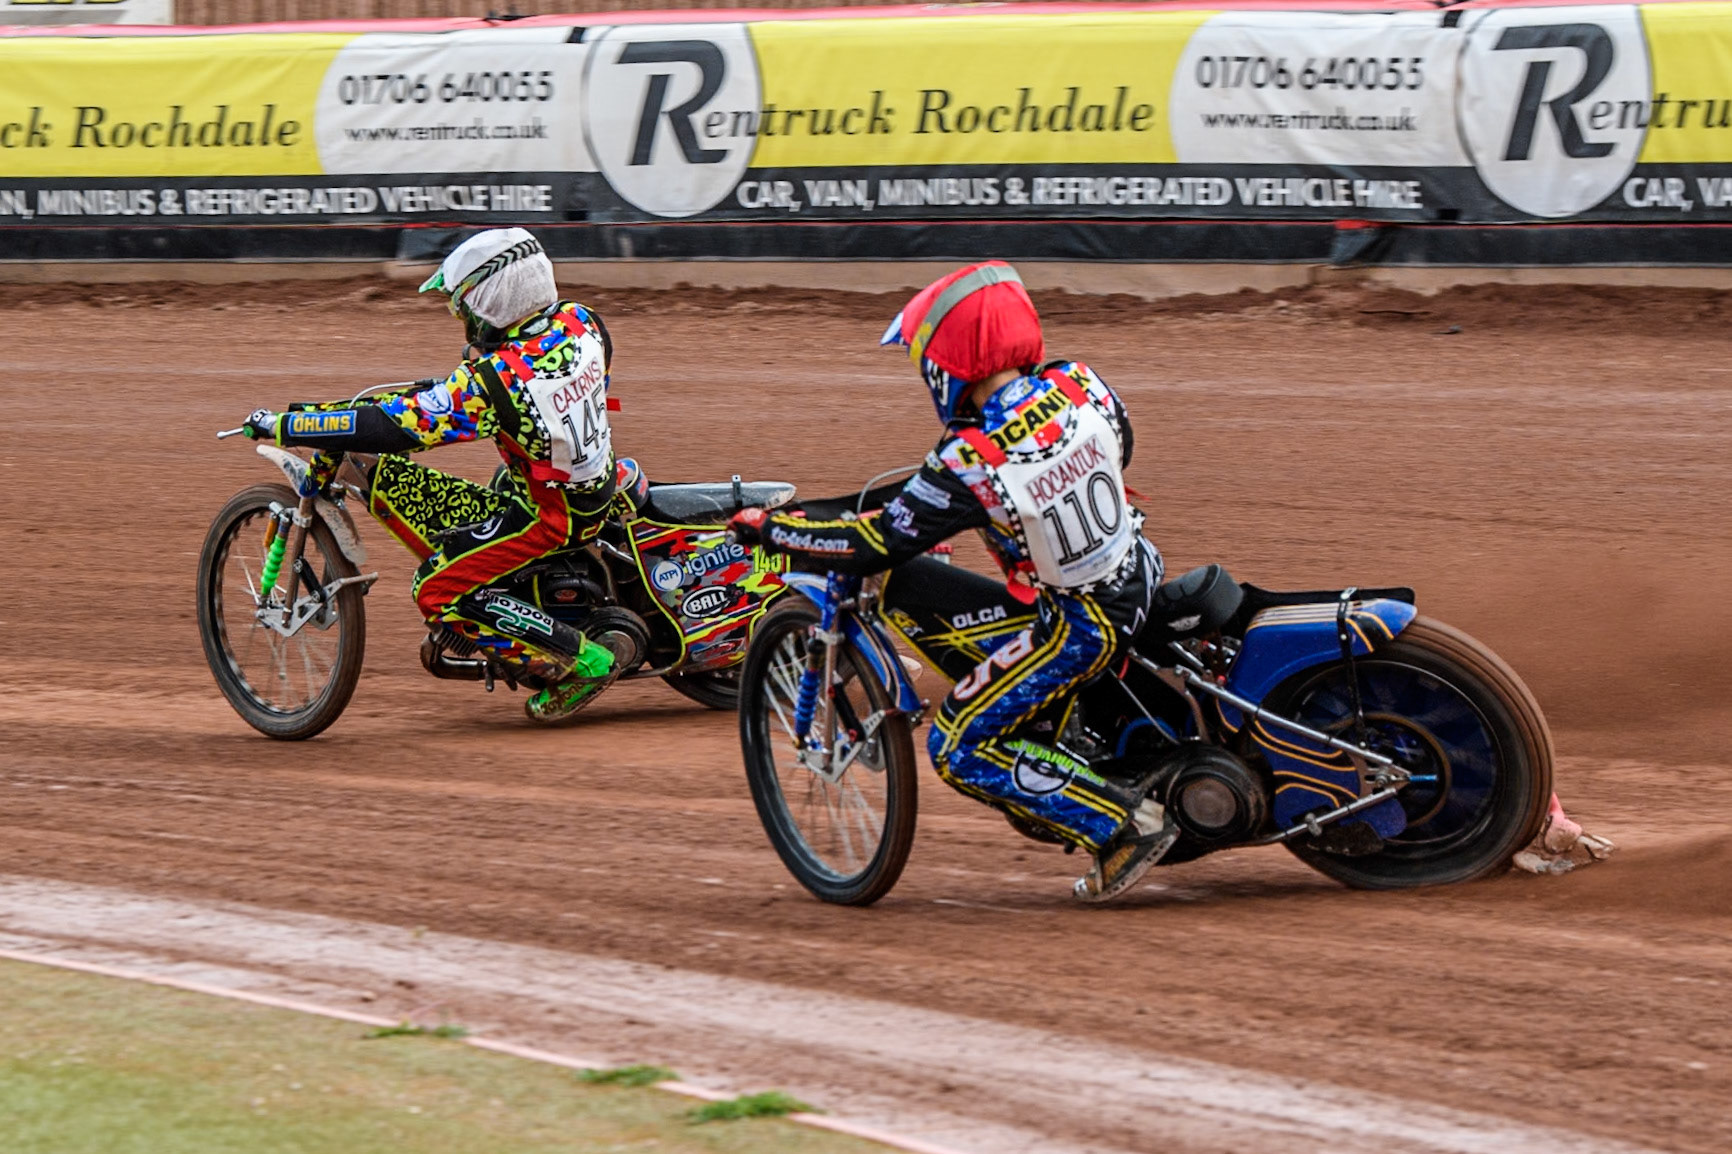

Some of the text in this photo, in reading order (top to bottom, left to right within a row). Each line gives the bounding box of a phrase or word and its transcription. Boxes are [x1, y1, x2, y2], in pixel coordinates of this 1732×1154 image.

[338, 71, 554, 105] 01706 640055
[1195, 55, 1424, 91] 01706 640055
[0, 104, 302, 148] ck Rochdale
[914, 86, 1155, 135] Rochdale
[1201, 108, 1417, 132] www.rentruck.co.uk
[345, 117, 549, 141] www.rentruck.co.uk
[37, 189, 156, 215] MINIBUS
[158, 188, 184, 215] &
[185, 187, 377, 214] REFRIGERATED
[378, 185, 488, 213] VEHICLE
[490, 185, 552, 212] HIRE
[737, 175, 1423, 213] CAR, VAN, MINIBUS & REFRIGERATED VEHICLE HIRE
[1622, 177, 1694, 213] CAR,
[552, 359, 602, 414] CAIRNS
[1025, 438, 1107, 509] HOCANIUK
[1042, 470, 1122, 566] 110
[658, 569, 679, 583] ATPI
[684, 543, 745, 577] ignite
[511, 602, 553, 627] ROCK
[952, 604, 1008, 630] OLGA
